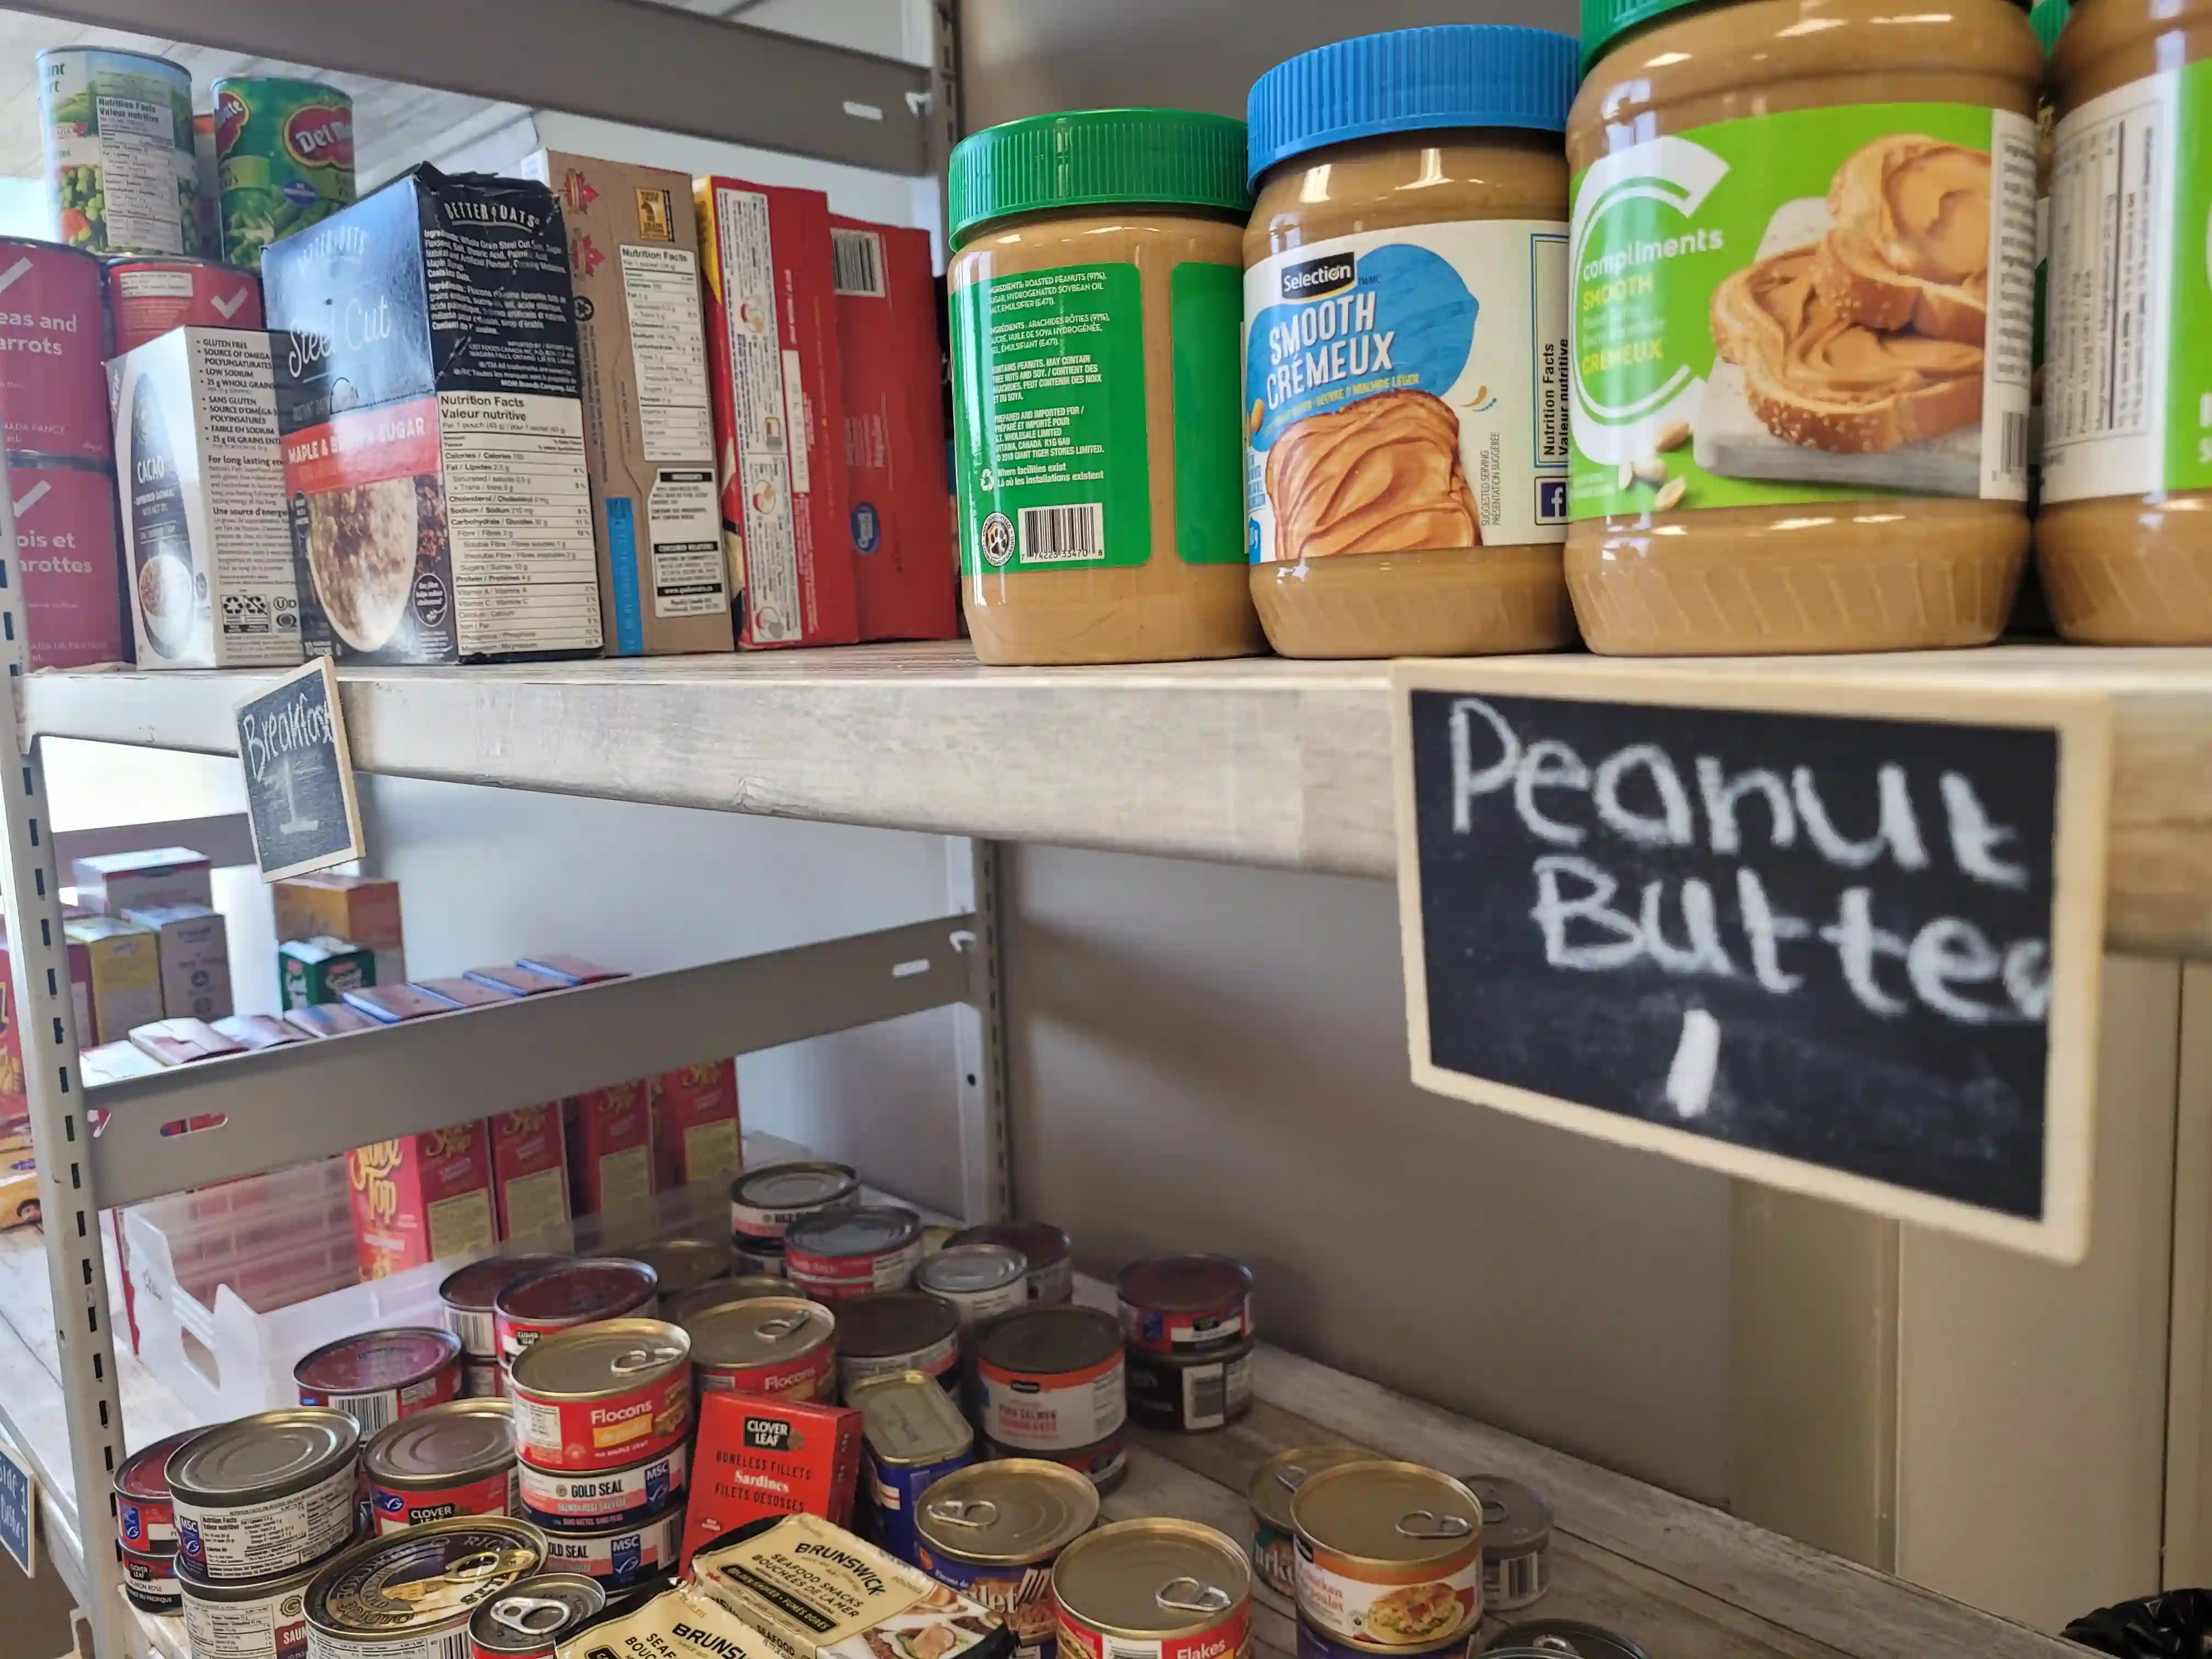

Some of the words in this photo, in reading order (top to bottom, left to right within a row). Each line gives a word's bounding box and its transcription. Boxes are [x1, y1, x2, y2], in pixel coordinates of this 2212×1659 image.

[444, 202, 489, 220] BETTER
[1583, 227, 1724, 281] compliments
[1025, 278, 1054, 287] ROASTED
[1054, 273, 1086, 284] PEANUTS
[1283, 264, 1351, 294] Selection
[1007, 287, 1057, 301] HYDROGENATED
[1058, 283, 1091, 294] SOYBEAN
[1583, 272, 1654, 312] SMOOTH
[1002, 300, 1034, 312] EMULSIFIER
[40, 313, 76, 333] and
[346, 295, 391, 352] Cut
[1028, 317, 1064, 328] ARACHIDES
[1065, 313, 1090, 323] RÔTIES
[1268, 291, 1377, 367] SMOOTH
[203, 338, 231, 348] GLUTEN
[1008, 331, 1025, 341] HUILE
[1026, 330, 1035, 338] DE
[1036, 328, 1052, 337] SOYA
[204, 348, 232, 357] SOURCE
[1046, 357, 1060, 366] MAY
[1062, 354, 1091, 365] CONTAIN
[1265, 329, 1395, 412] CRÉMEUX
[1542, 343, 1554, 385] Facts
[206, 368, 223, 376] LOW
[224, 370, 253, 378] SODIUM
[1005, 372, 1019, 382] NUTS
[1019, 370, 1032, 380] AND
[1052, 365, 1083, 376] CONTIENT
[1085, 364, 1098, 373] DES
[1023, 381, 1037, 390] PEUT
[1039, 378, 1069, 388] CONTENIR
[1071, 375, 1085, 385] DES
[1086, 374, 1102, 383] NOIX
[210, 405, 235, 414] SOURCE
[228, 397, 257, 405] GLUTEN
[441, 395, 492, 406] Nutrition
[493, 396, 525, 408] Facts
[441, 409, 479, 419] Valeur
[482, 409, 527, 421] nutritive
[1020, 410, 1033, 420] AND
[1034, 407, 1065, 418] IMPORTED
[1066, 406, 1080, 415] FOR
[1017, 421, 1025, 430] ET
[1052, 416, 1070, 426] POUR
[1543, 390, 1555, 456] Nutrition
[1005, 430, 1037, 442] WHOLESALE
[1037, 427, 1062, 438] LIMITED
[289, 442, 318, 464] MAPLE
[1014, 449, 1031, 460] GIANT
[1032, 448, 1049, 459] TIGER
[1050, 446, 1075, 458] STORES
[1018, 439, 1042, 450] CANADA
[208, 455, 222, 464] For
[223, 455, 241, 466] long
[244, 456, 270, 468] lasting
[997, 467, 1017, 477] Where
[1017, 464, 1047, 475] facilities
[1048, 462, 1067, 472] exist
[1015, 476, 1025, 486] les
[1025, 472, 1070, 485] installations
[1072, 470, 1104, 481] existent
[213, 507, 228, 516] Une
[230, 507, 254, 516] source
[53, 532, 76, 549] et
[1450, 697, 2029, 889] Peanut
[1666, 1008, 1721, 1119] 1
[590, 1401, 652, 1425] Flocons
[747, 1419, 788, 1436] CLOVER
[755, 1432, 780, 1447] LEAF
[715, 1449, 768, 1471] BONELESS
[770, 1460, 812, 1481] FILLETS
[571, 1483, 596, 1498] GOLD
[599, 1480, 624, 1496] SEAL
[646, 1462, 668, 1480] MSC
[734, 1469, 789, 1494] Sardines
[715, 1482, 750, 1501] FILETS
[410, 1506, 452, 1519] CLOVER
[180, 1518, 198, 1533] MSC
[566, 1543, 589, 1559] SEAL
[612, 1536, 640, 1552] MSC
[794, 1542, 887, 1596] BRUNSWICK
[771, 1553, 822, 1584] SEAFOOD
[820, 1582, 865, 1609] SNACKS
[805, 1584, 821, 1595] DE
[833, 1601, 860, 1618] MER
[756, 1624, 795, 1657] SEAFOOD
[1176, 1640, 1226, 1659] Flakes
